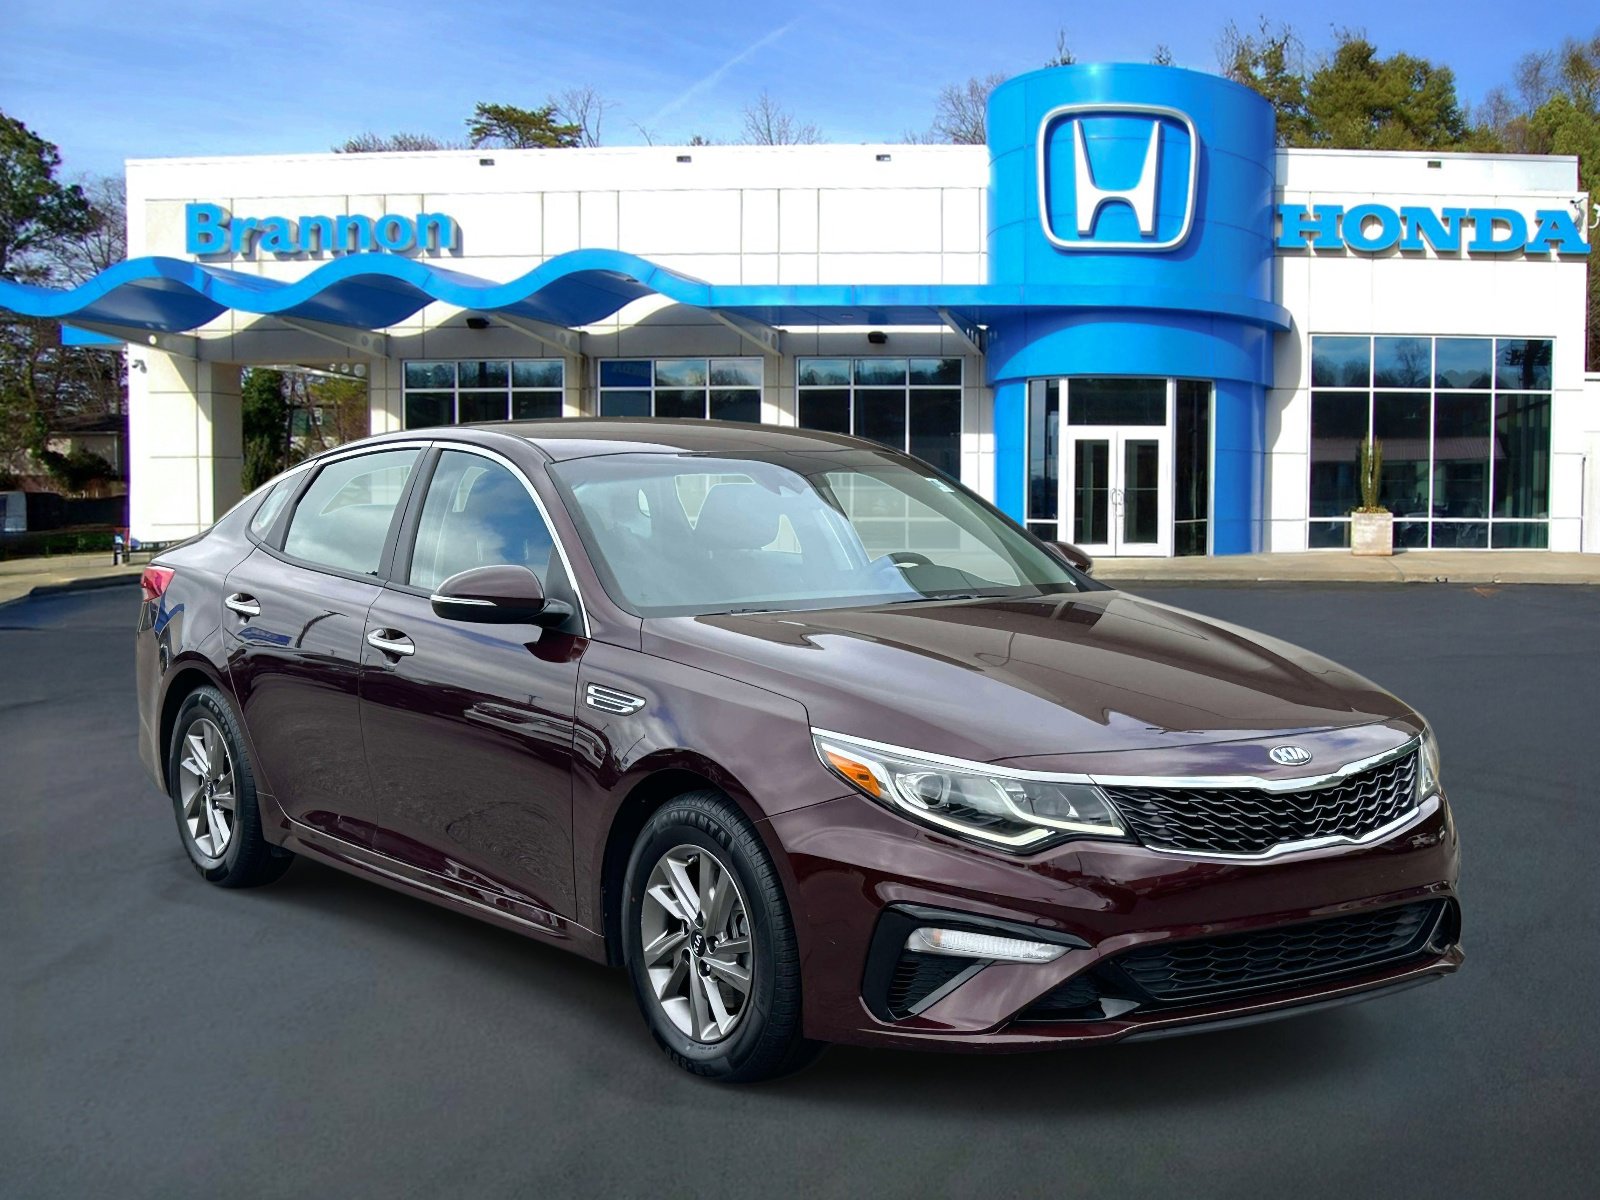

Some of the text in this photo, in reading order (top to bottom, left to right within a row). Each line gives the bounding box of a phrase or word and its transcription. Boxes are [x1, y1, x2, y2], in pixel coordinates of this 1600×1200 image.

[185, 202, 459, 256] Brannon
[1276, 203, 1592, 255] HONDA
[1273, 746, 1310, 762] KIA
[692, 933, 703, 954] KIA
